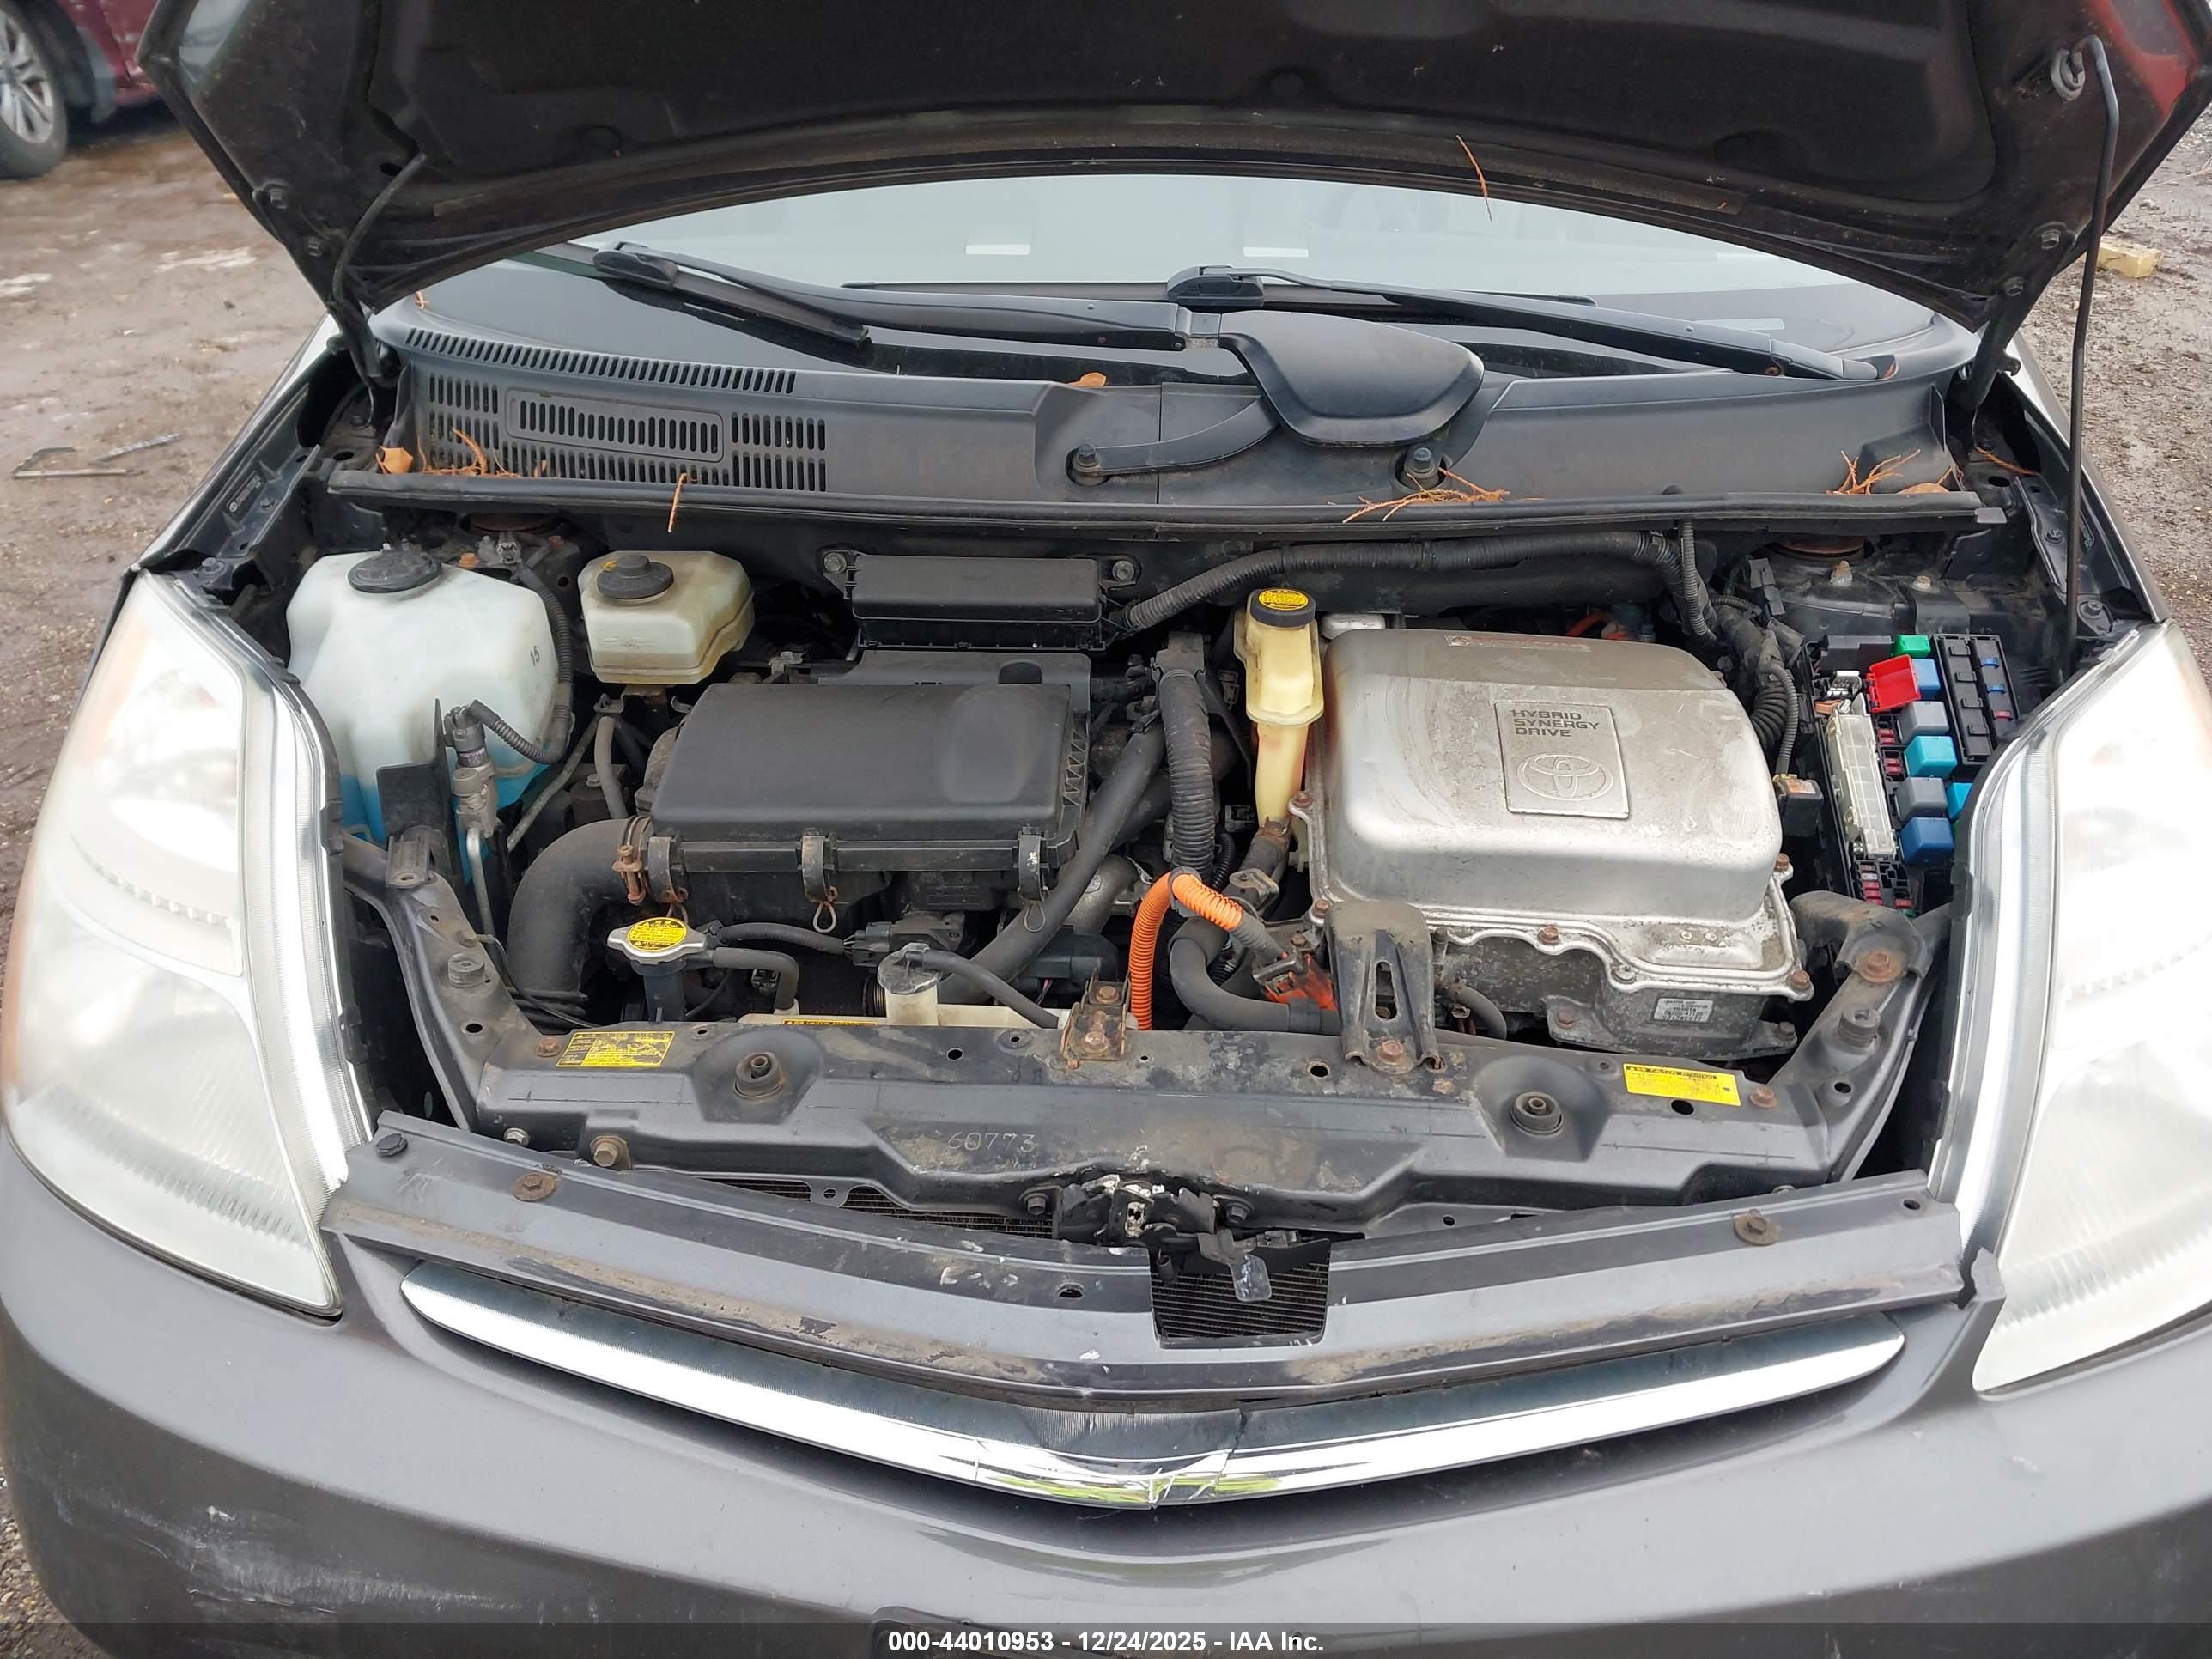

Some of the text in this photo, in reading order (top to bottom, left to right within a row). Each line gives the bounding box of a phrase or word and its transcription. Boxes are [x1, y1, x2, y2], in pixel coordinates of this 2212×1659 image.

[530, 645, 540, 667] 15
[1511, 709, 1582, 720] HYBRID
[1514, 719, 1599, 730] SYNERGY
[1516, 727, 1571, 737] DRIVE
[947, 1132, 1037, 1152] 60773
